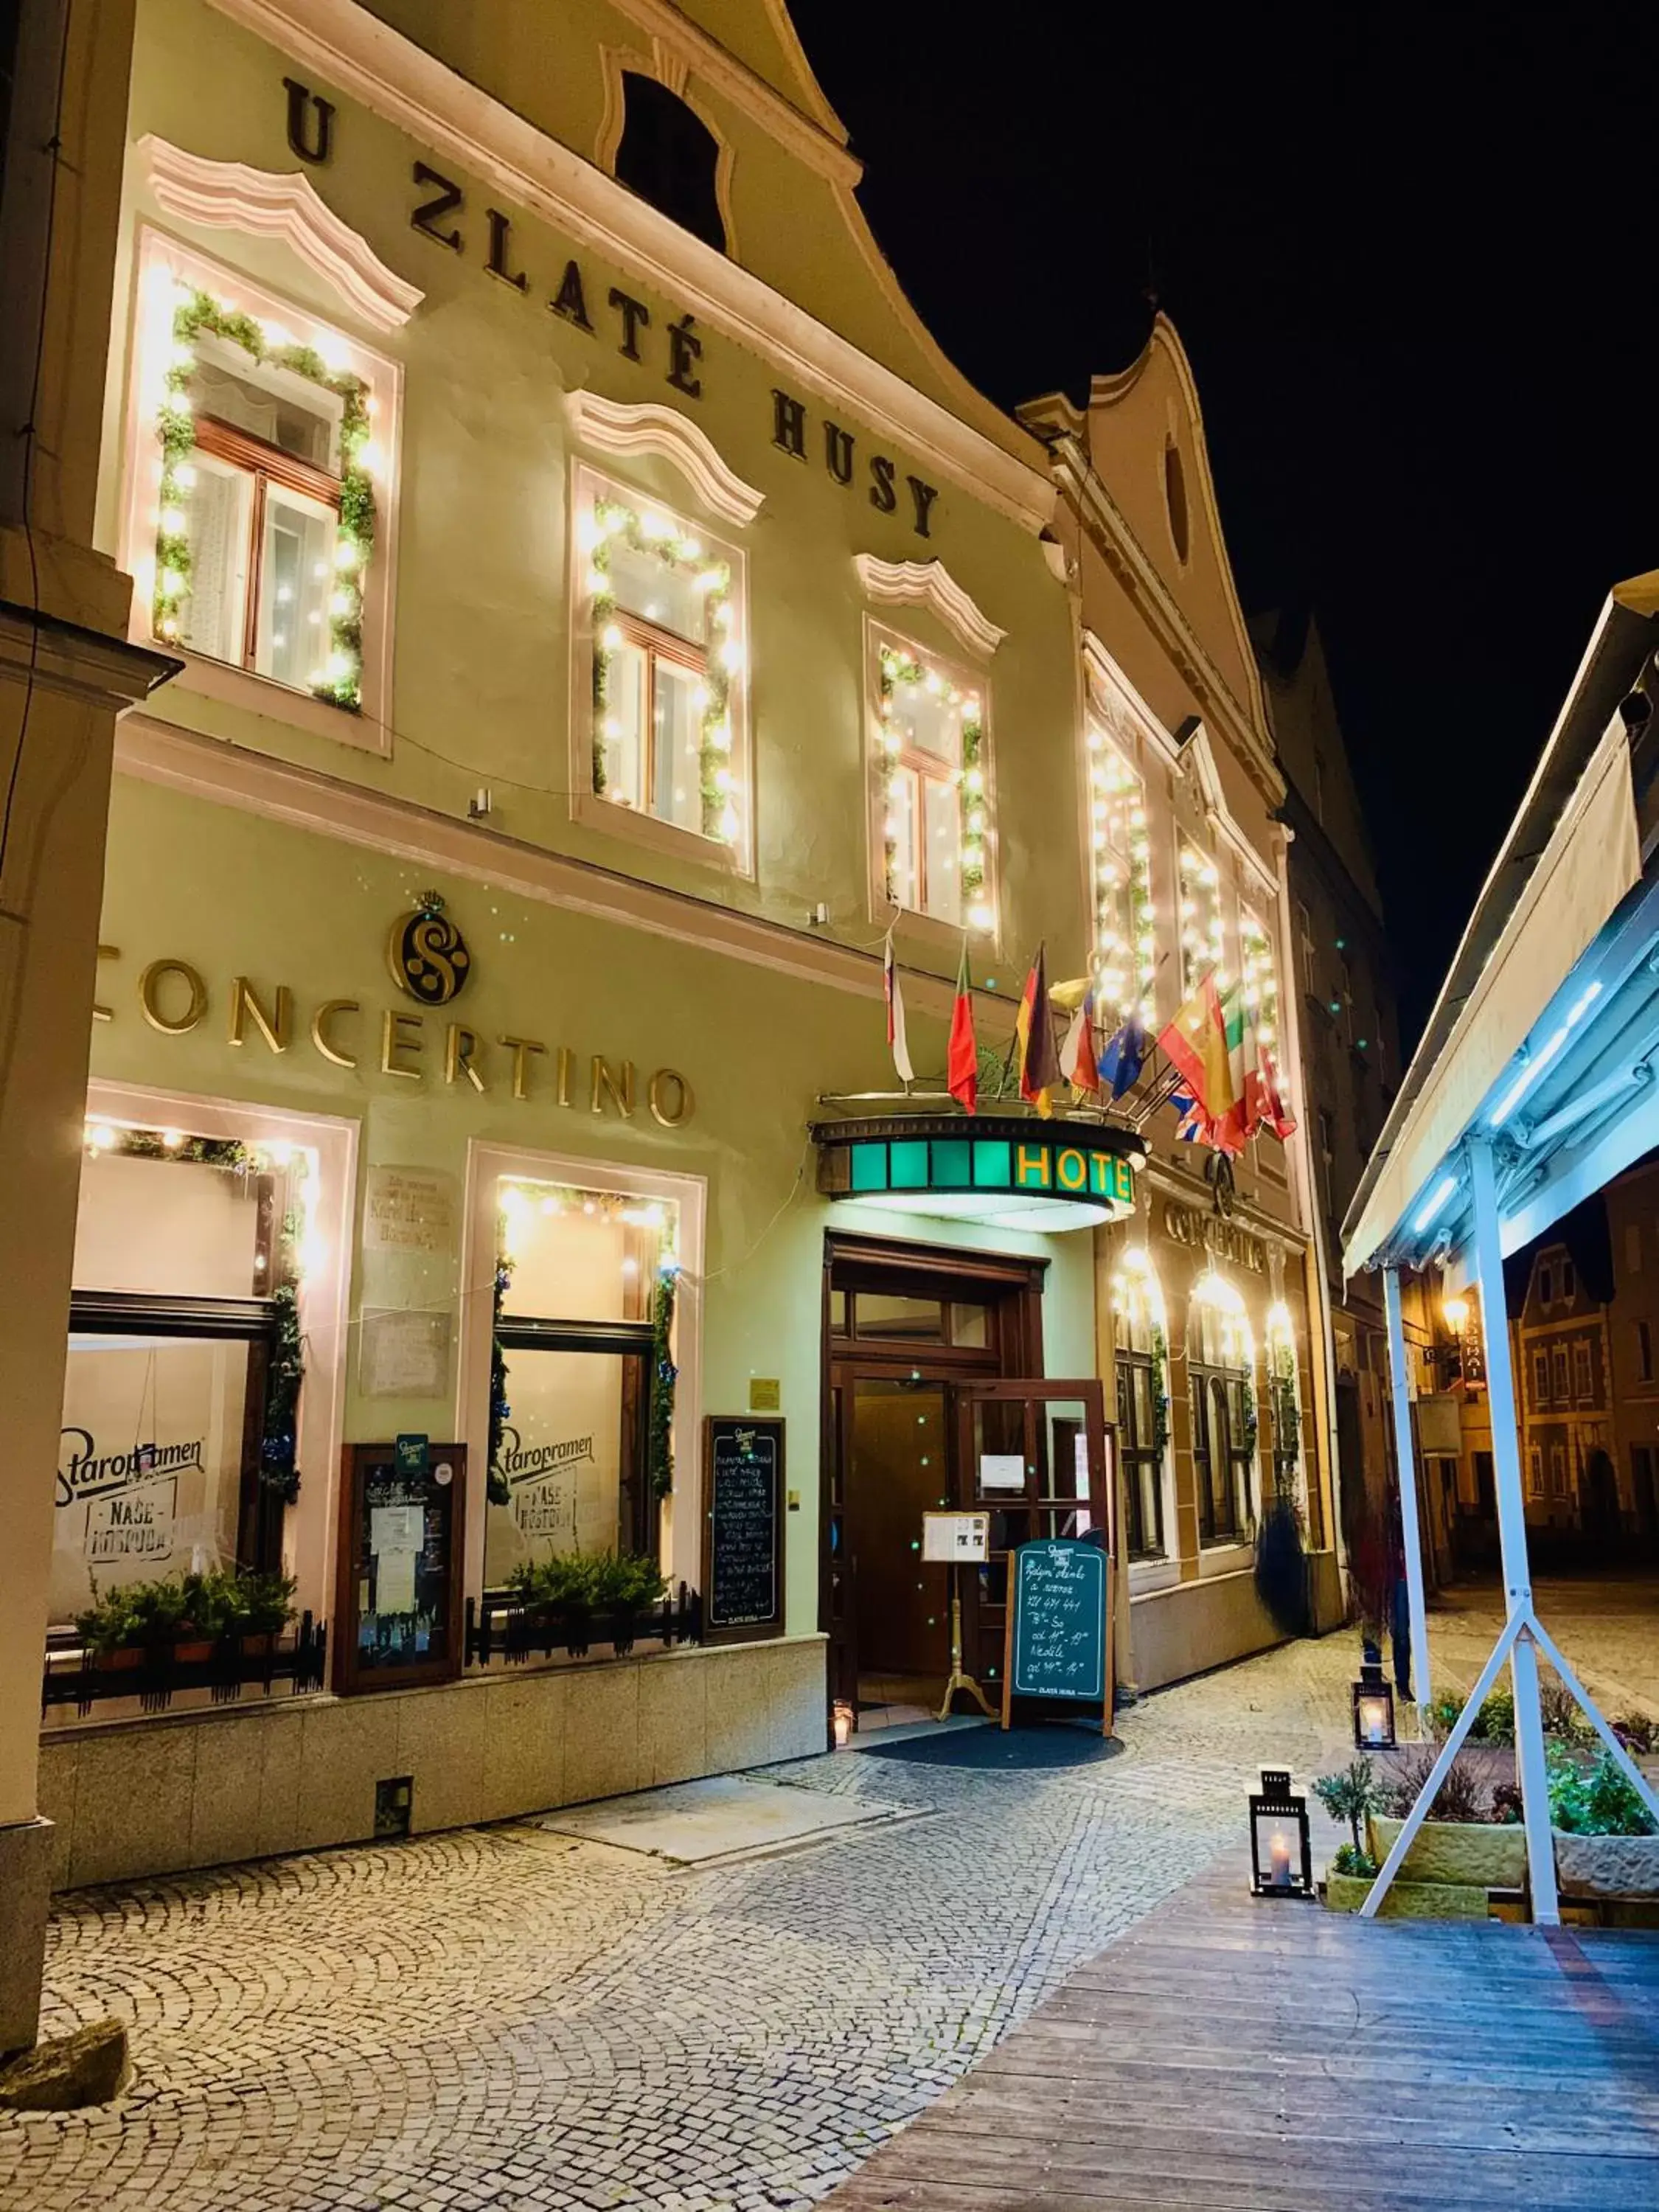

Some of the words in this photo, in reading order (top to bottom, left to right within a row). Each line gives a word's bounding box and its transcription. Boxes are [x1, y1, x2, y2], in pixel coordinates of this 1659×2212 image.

[282, 77, 335, 165] U
[410, 160, 703, 400] ZLATÉ
[771, 388, 938, 538] HUSY
[55, 1427, 201, 1508] Staropamen
